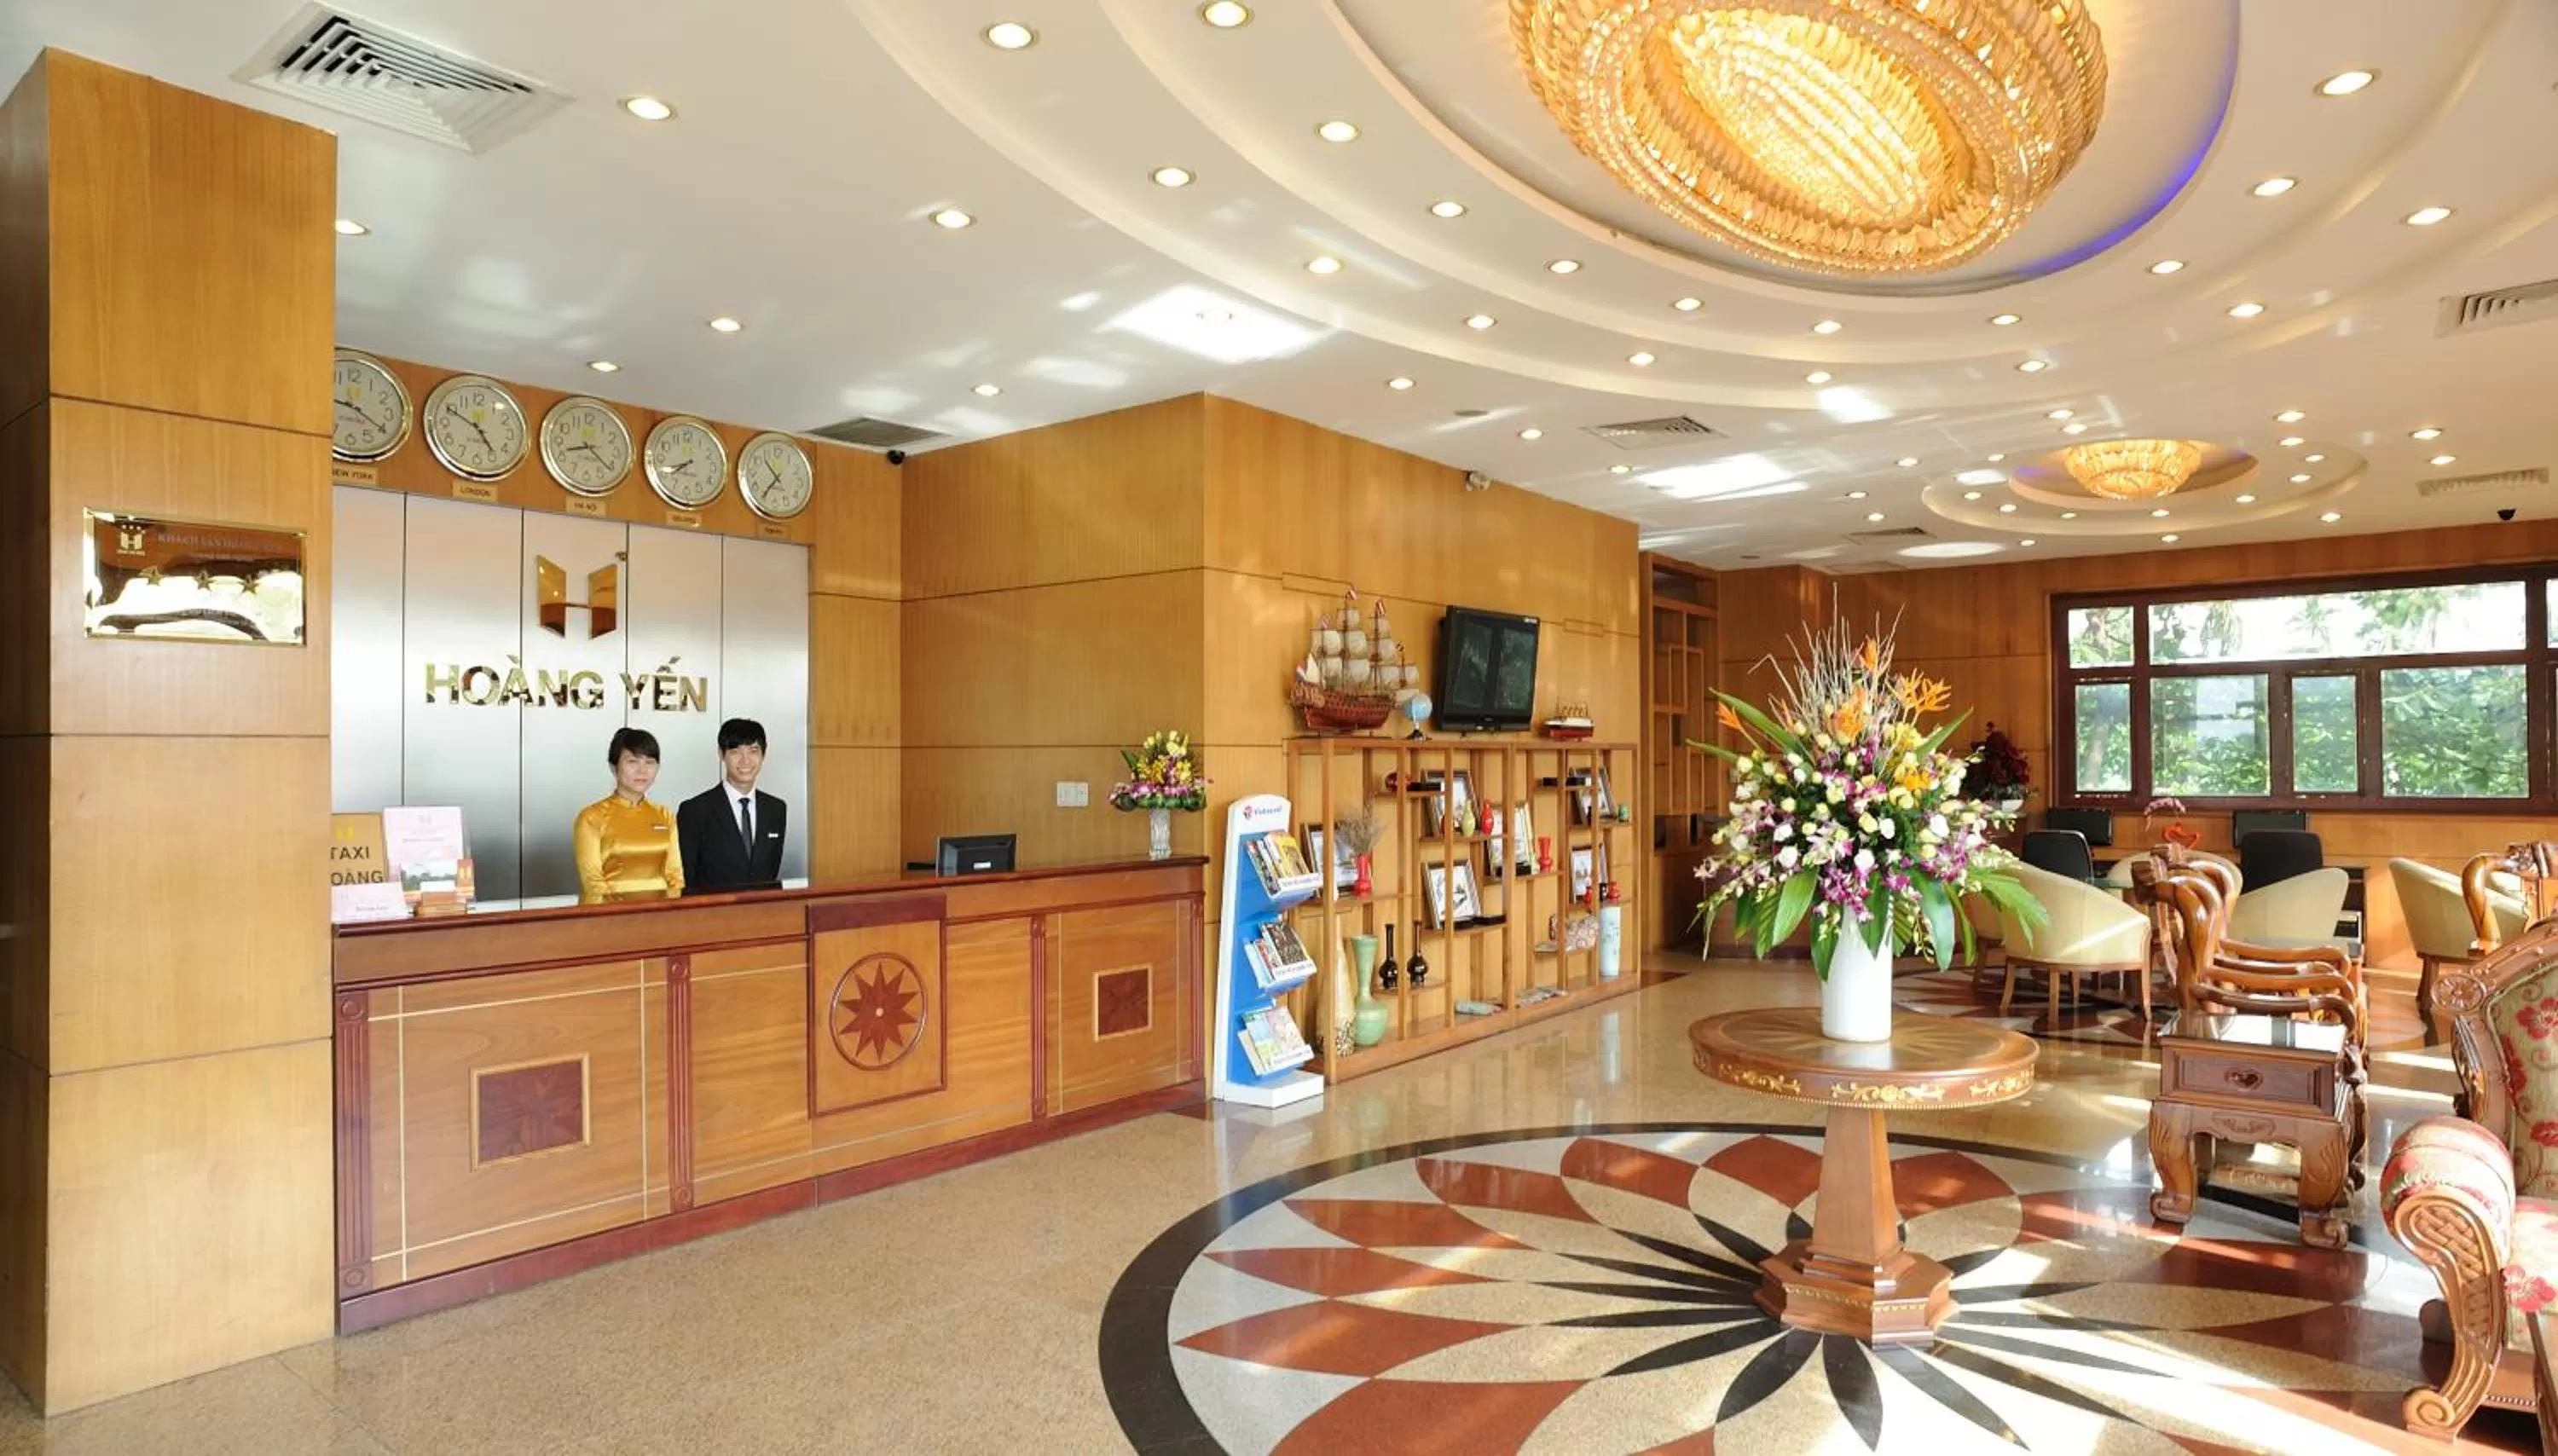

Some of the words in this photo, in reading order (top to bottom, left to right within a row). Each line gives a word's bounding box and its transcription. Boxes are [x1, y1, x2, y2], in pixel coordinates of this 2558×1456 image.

[347, 368, 362, 384] 12
[460, 395, 468, 409] 11
[473, 391, 485, 406] 12
[573, 415, 580, 430] 11
[585, 413, 595, 425] 12
[344, 433, 356, 446] 6
[362, 429, 374, 444] 5
[458, 444, 466, 458] 7
[425, 654, 605, 710] HOÀNG
[620, 656, 709, 713] YẾN
[330, 846, 369, 859] TAXI
[330, 867, 383, 886] OÀNG
